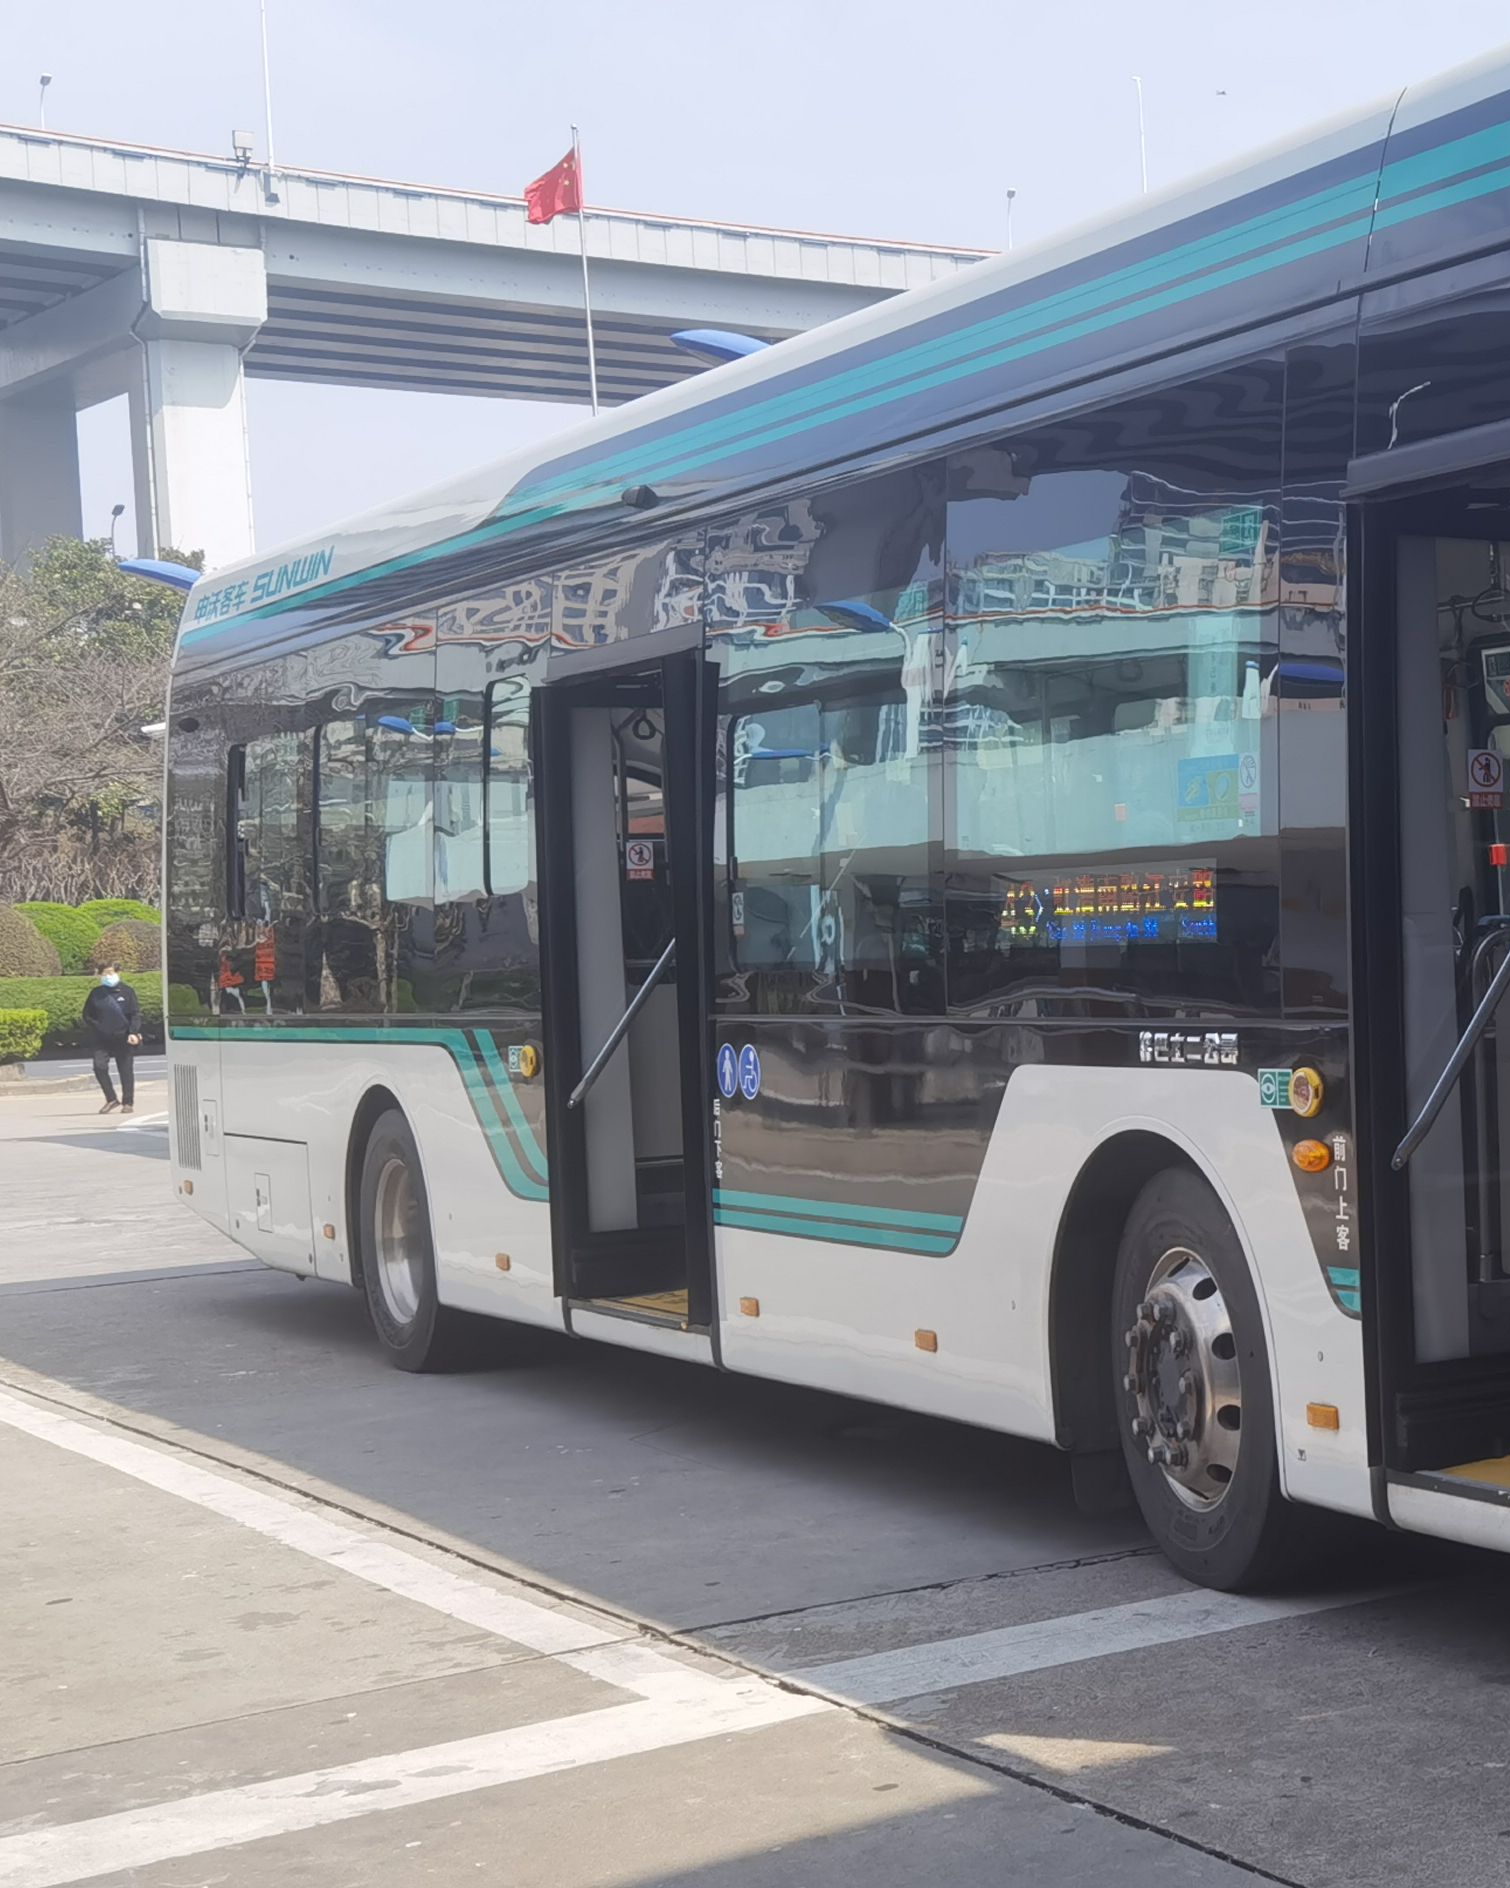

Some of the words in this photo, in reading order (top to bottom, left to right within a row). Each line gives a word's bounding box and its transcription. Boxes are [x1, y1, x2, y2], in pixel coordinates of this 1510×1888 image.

[250, 545, 335, 604] SUNWIN
[1332, 1135, 1350, 1251] 前门上客
